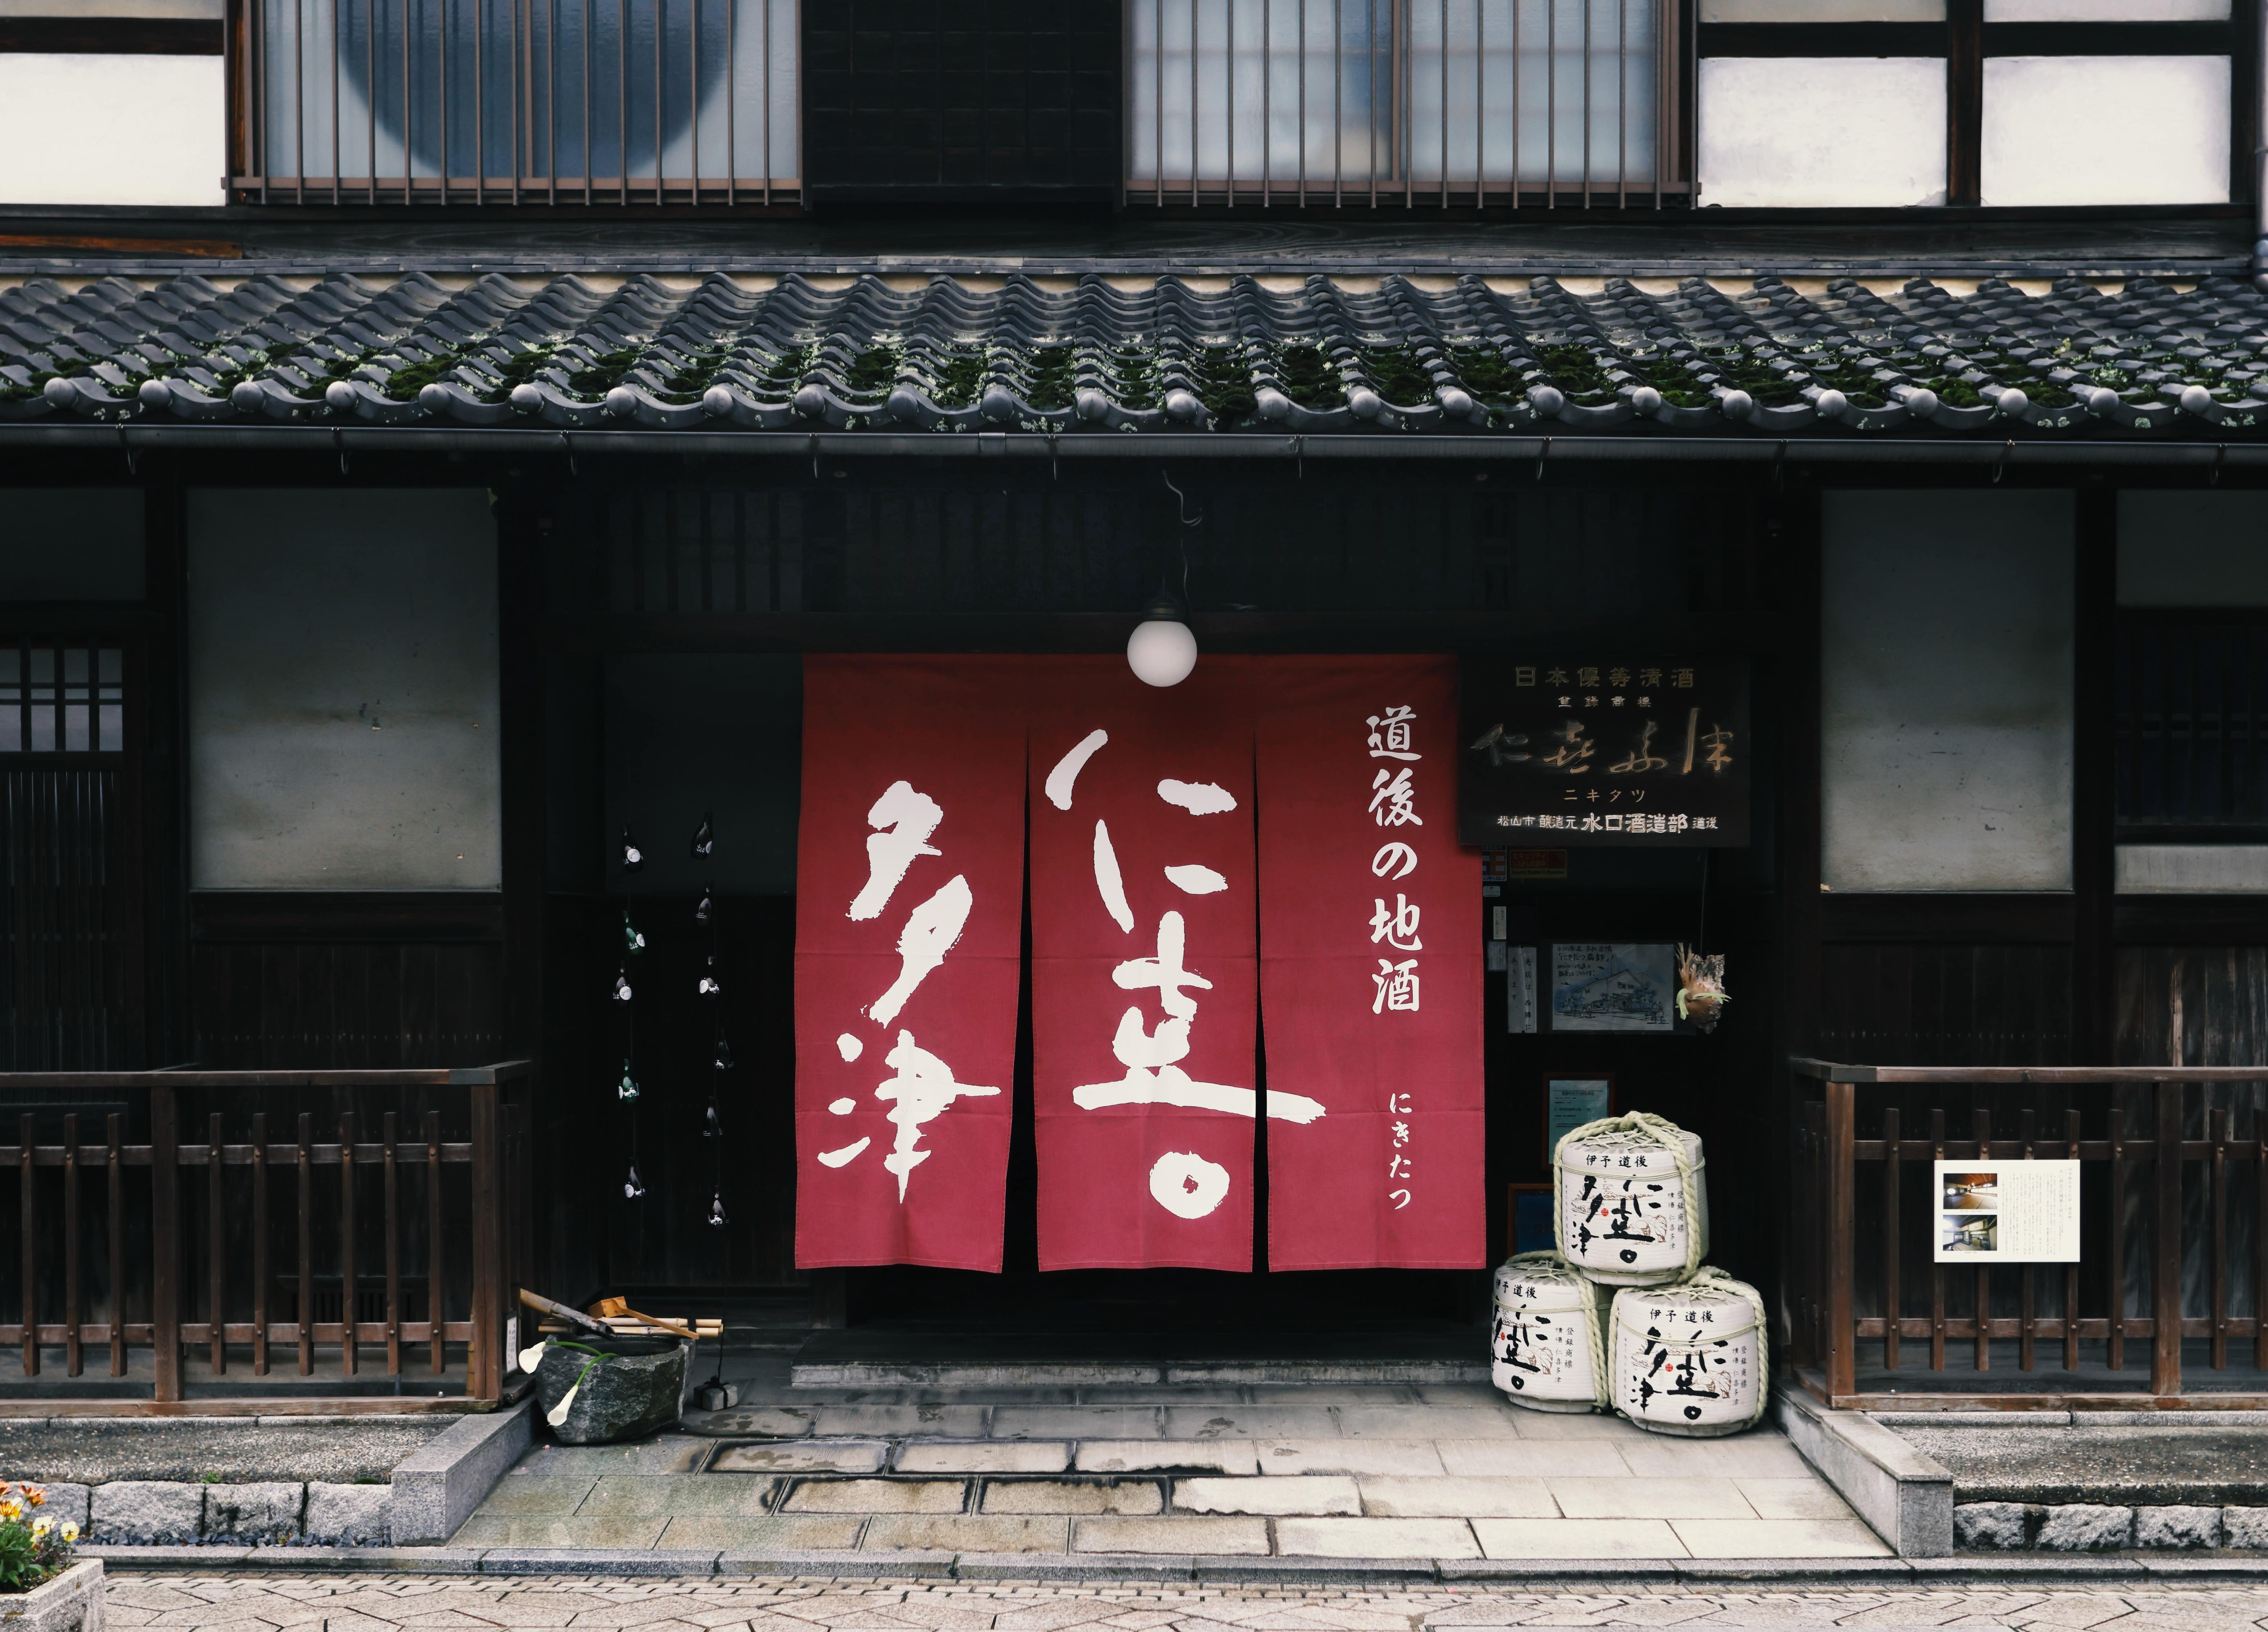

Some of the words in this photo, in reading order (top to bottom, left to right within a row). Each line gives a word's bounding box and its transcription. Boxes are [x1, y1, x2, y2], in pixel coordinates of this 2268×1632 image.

[1516, 667, 1694, 687] 日本優等清酒
[1558, 696, 1651, 707] 登録商標
[1564, 789, 1645, 802] ニキタツ
[1497, 815, 1536, 826] 松山市
[1692, 817, 1718, 829] 道後
[1366, 705, 1423, 1014] 道後の地酒
[1389, 1093, 1412, 1210] にきたつ
[1586, 1154, 1611, 1168] 伊予
[1618, 1155, 1648, 1168] 道後
[1496, 1278, 1509, 1293] 伊予
[1513, 1284, 1537, 1299] 道後
[1650, 1308, 1676, 1322] 伊予
[1685, 1310, 1714, 1323] 道後
[1565, 1327, 1575, 1369] 登録商標
